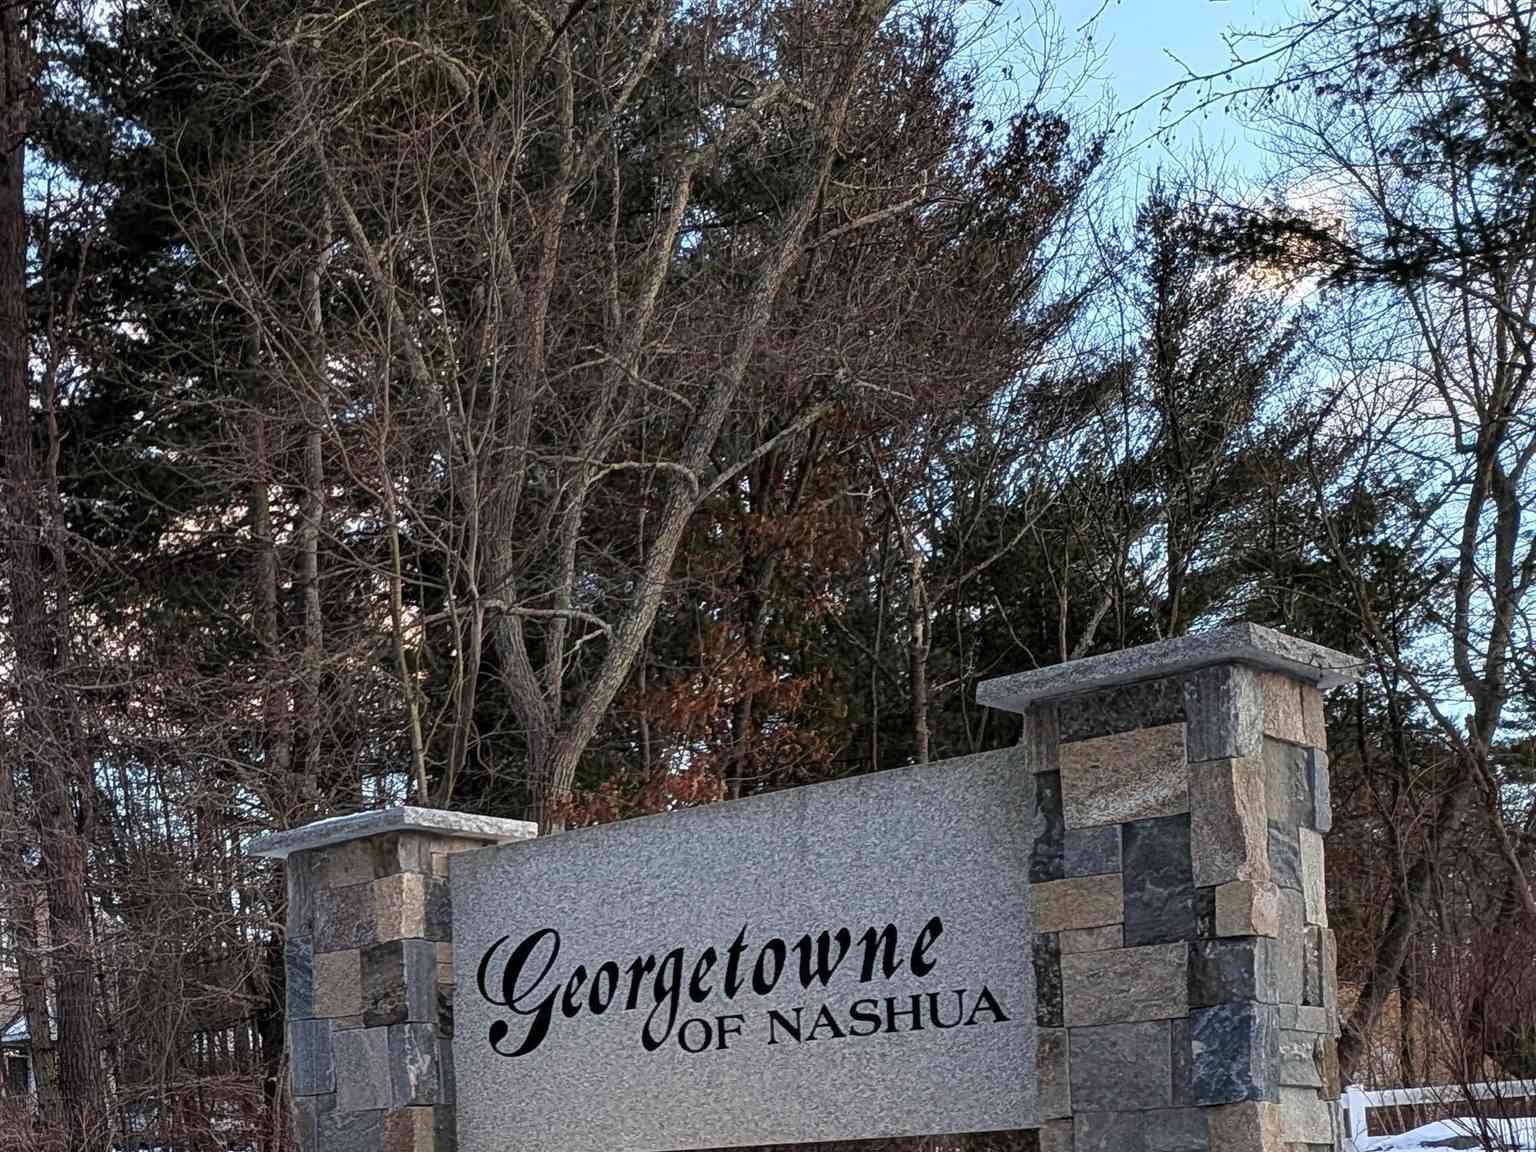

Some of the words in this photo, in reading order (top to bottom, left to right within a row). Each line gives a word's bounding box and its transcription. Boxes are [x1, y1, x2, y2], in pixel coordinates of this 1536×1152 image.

[476, 915, 944, 1058] Georgetowne
[678, 1013, 744, 1053] OF
[767, 985, 1010, 1045] NASHUA
